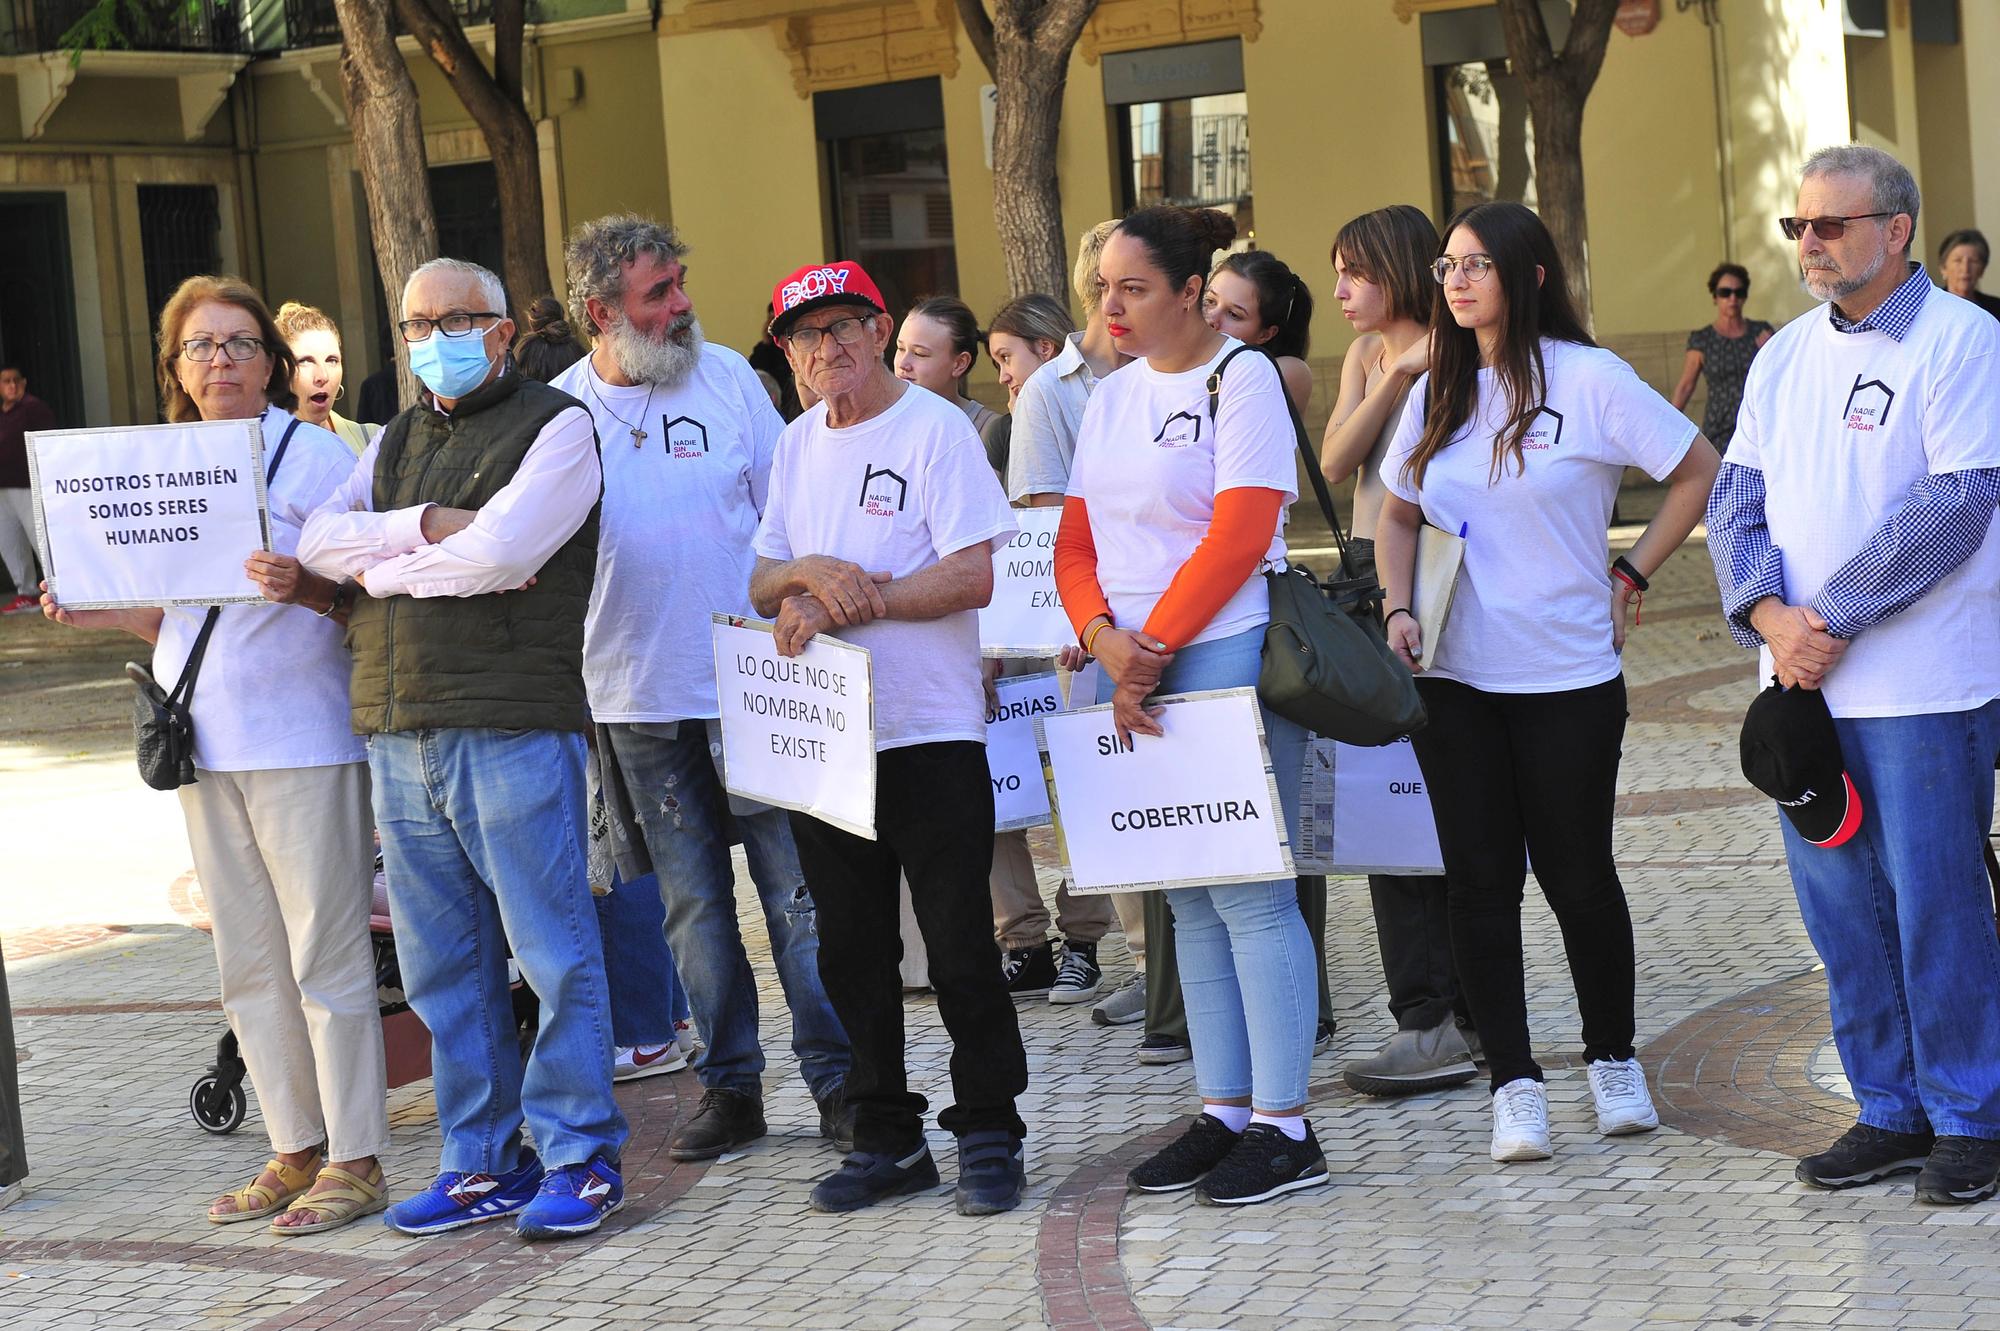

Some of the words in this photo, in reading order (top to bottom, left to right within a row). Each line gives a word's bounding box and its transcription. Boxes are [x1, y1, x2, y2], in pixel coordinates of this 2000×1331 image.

[782, 268, 849, 310] BOY
[1850, 414, 1863, 422] SIN
[1853, 407, 1876, 416] NADIE
[1847, 422, 1874, 432] HOGAR
[674, 451, 702, 459] HOGAR
[55, 474, 151, 494] NOSOTROS
[156, 465, 238, 488] TAMBIÉN
[867, 501, 880, 509] SIN
[869, 494, 892, 503] NADIE
[89, 501, 153, 519] SOMOS
[158, 498, 208, 515] SERES
[865, 508, 894, 517] HOGAR
[105, 526, 199, 545] HUMANOS
[1031, 590, 1064, 608] EXI
[737, 653, 756, 676] LO
[762, 659, 800, 683] QUE
[806, 666, 829, 690] NO
[832, 673, 847, 696] SE
[743, 691, 822, 725] NOMBRA
[826, 706, 846, 732] NO
[771, 733, 827, 763] EXISTE
[992, 775, 1020, 793] YO
[1389, 782, 1422, 795] QUE
[1111, 799, 1260, 832] COBERTURA
